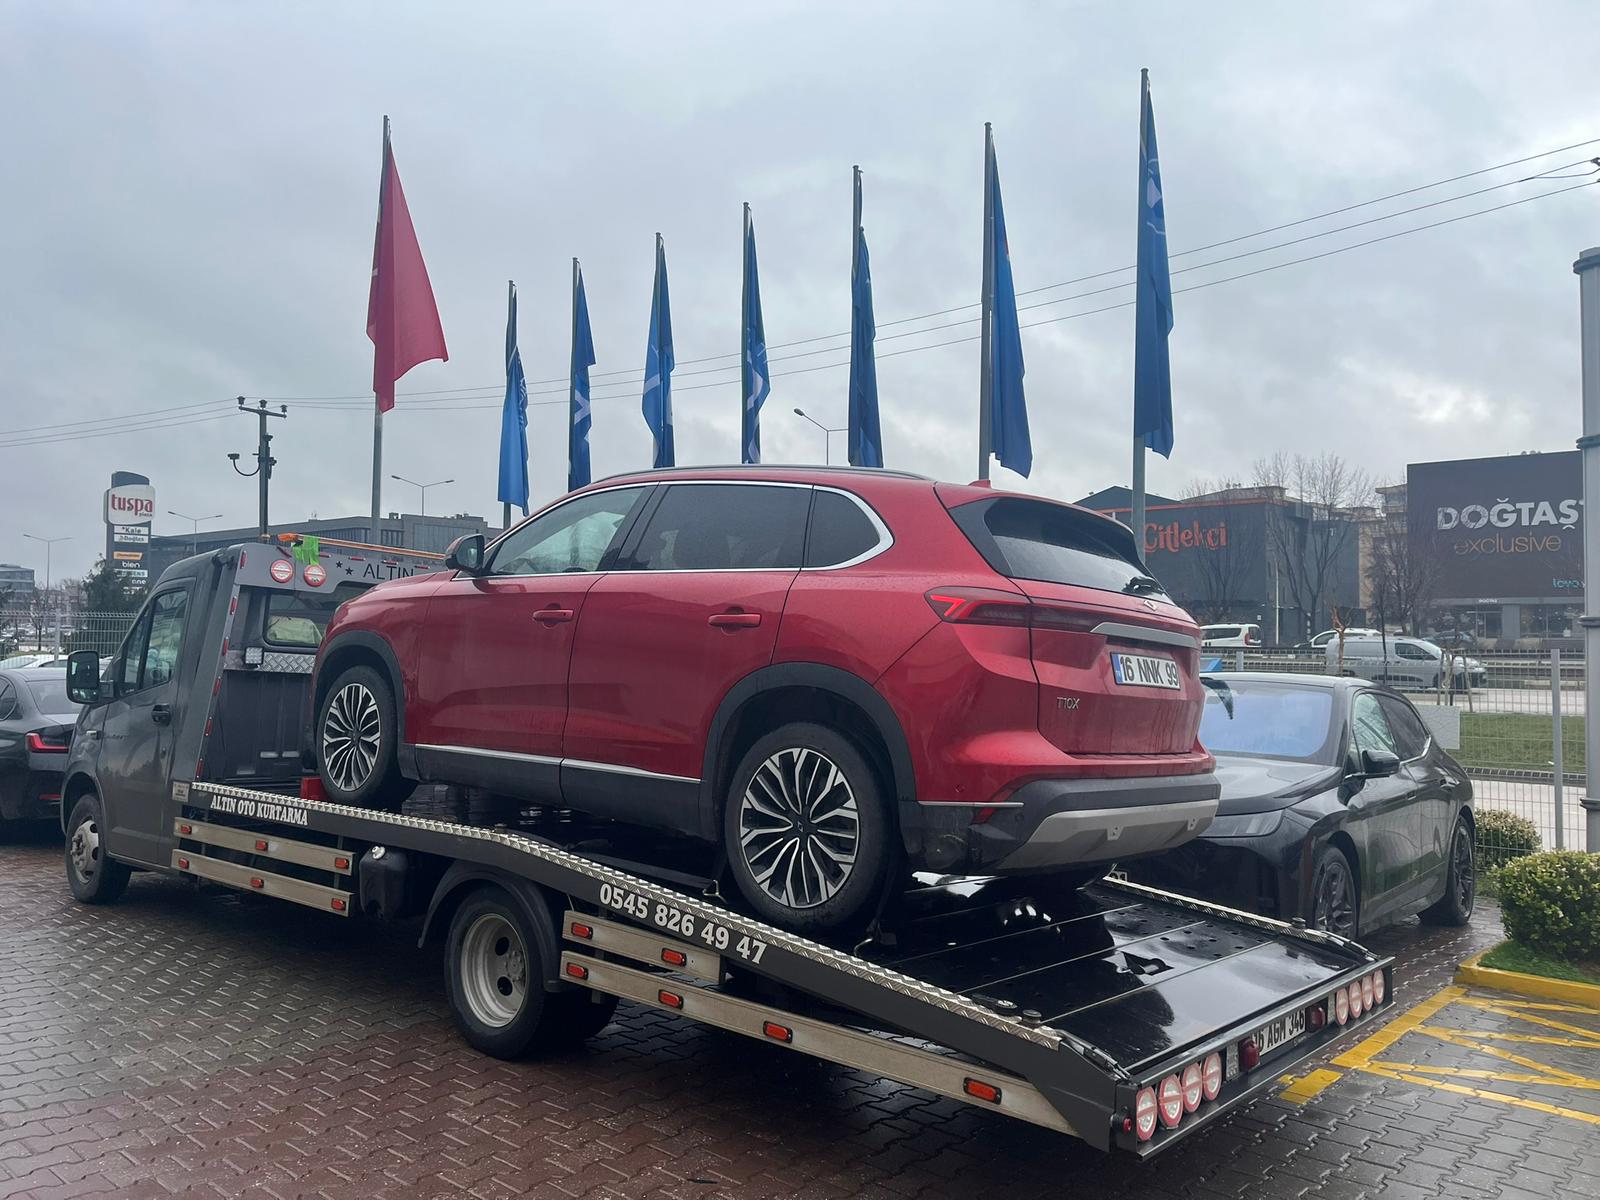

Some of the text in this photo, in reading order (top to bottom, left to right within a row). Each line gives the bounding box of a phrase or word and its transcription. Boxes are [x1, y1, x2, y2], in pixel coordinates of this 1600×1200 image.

[111, 494, 153, 516] tuspa
[1437, 498, 1579, 530] DOĞTAŞ
[1454, 531, 1561, 555] exclusive
[1120, 655, 1179, 687] 16 NNK 99
[210, 795, 308, 826] ALTIN OTO KURTARMA
[600, 883, 767, 965] 0545 826 49 47
[1267, 1018, 1286, 1048] AGM
[1289, 1009, 1305, 1035] 346
